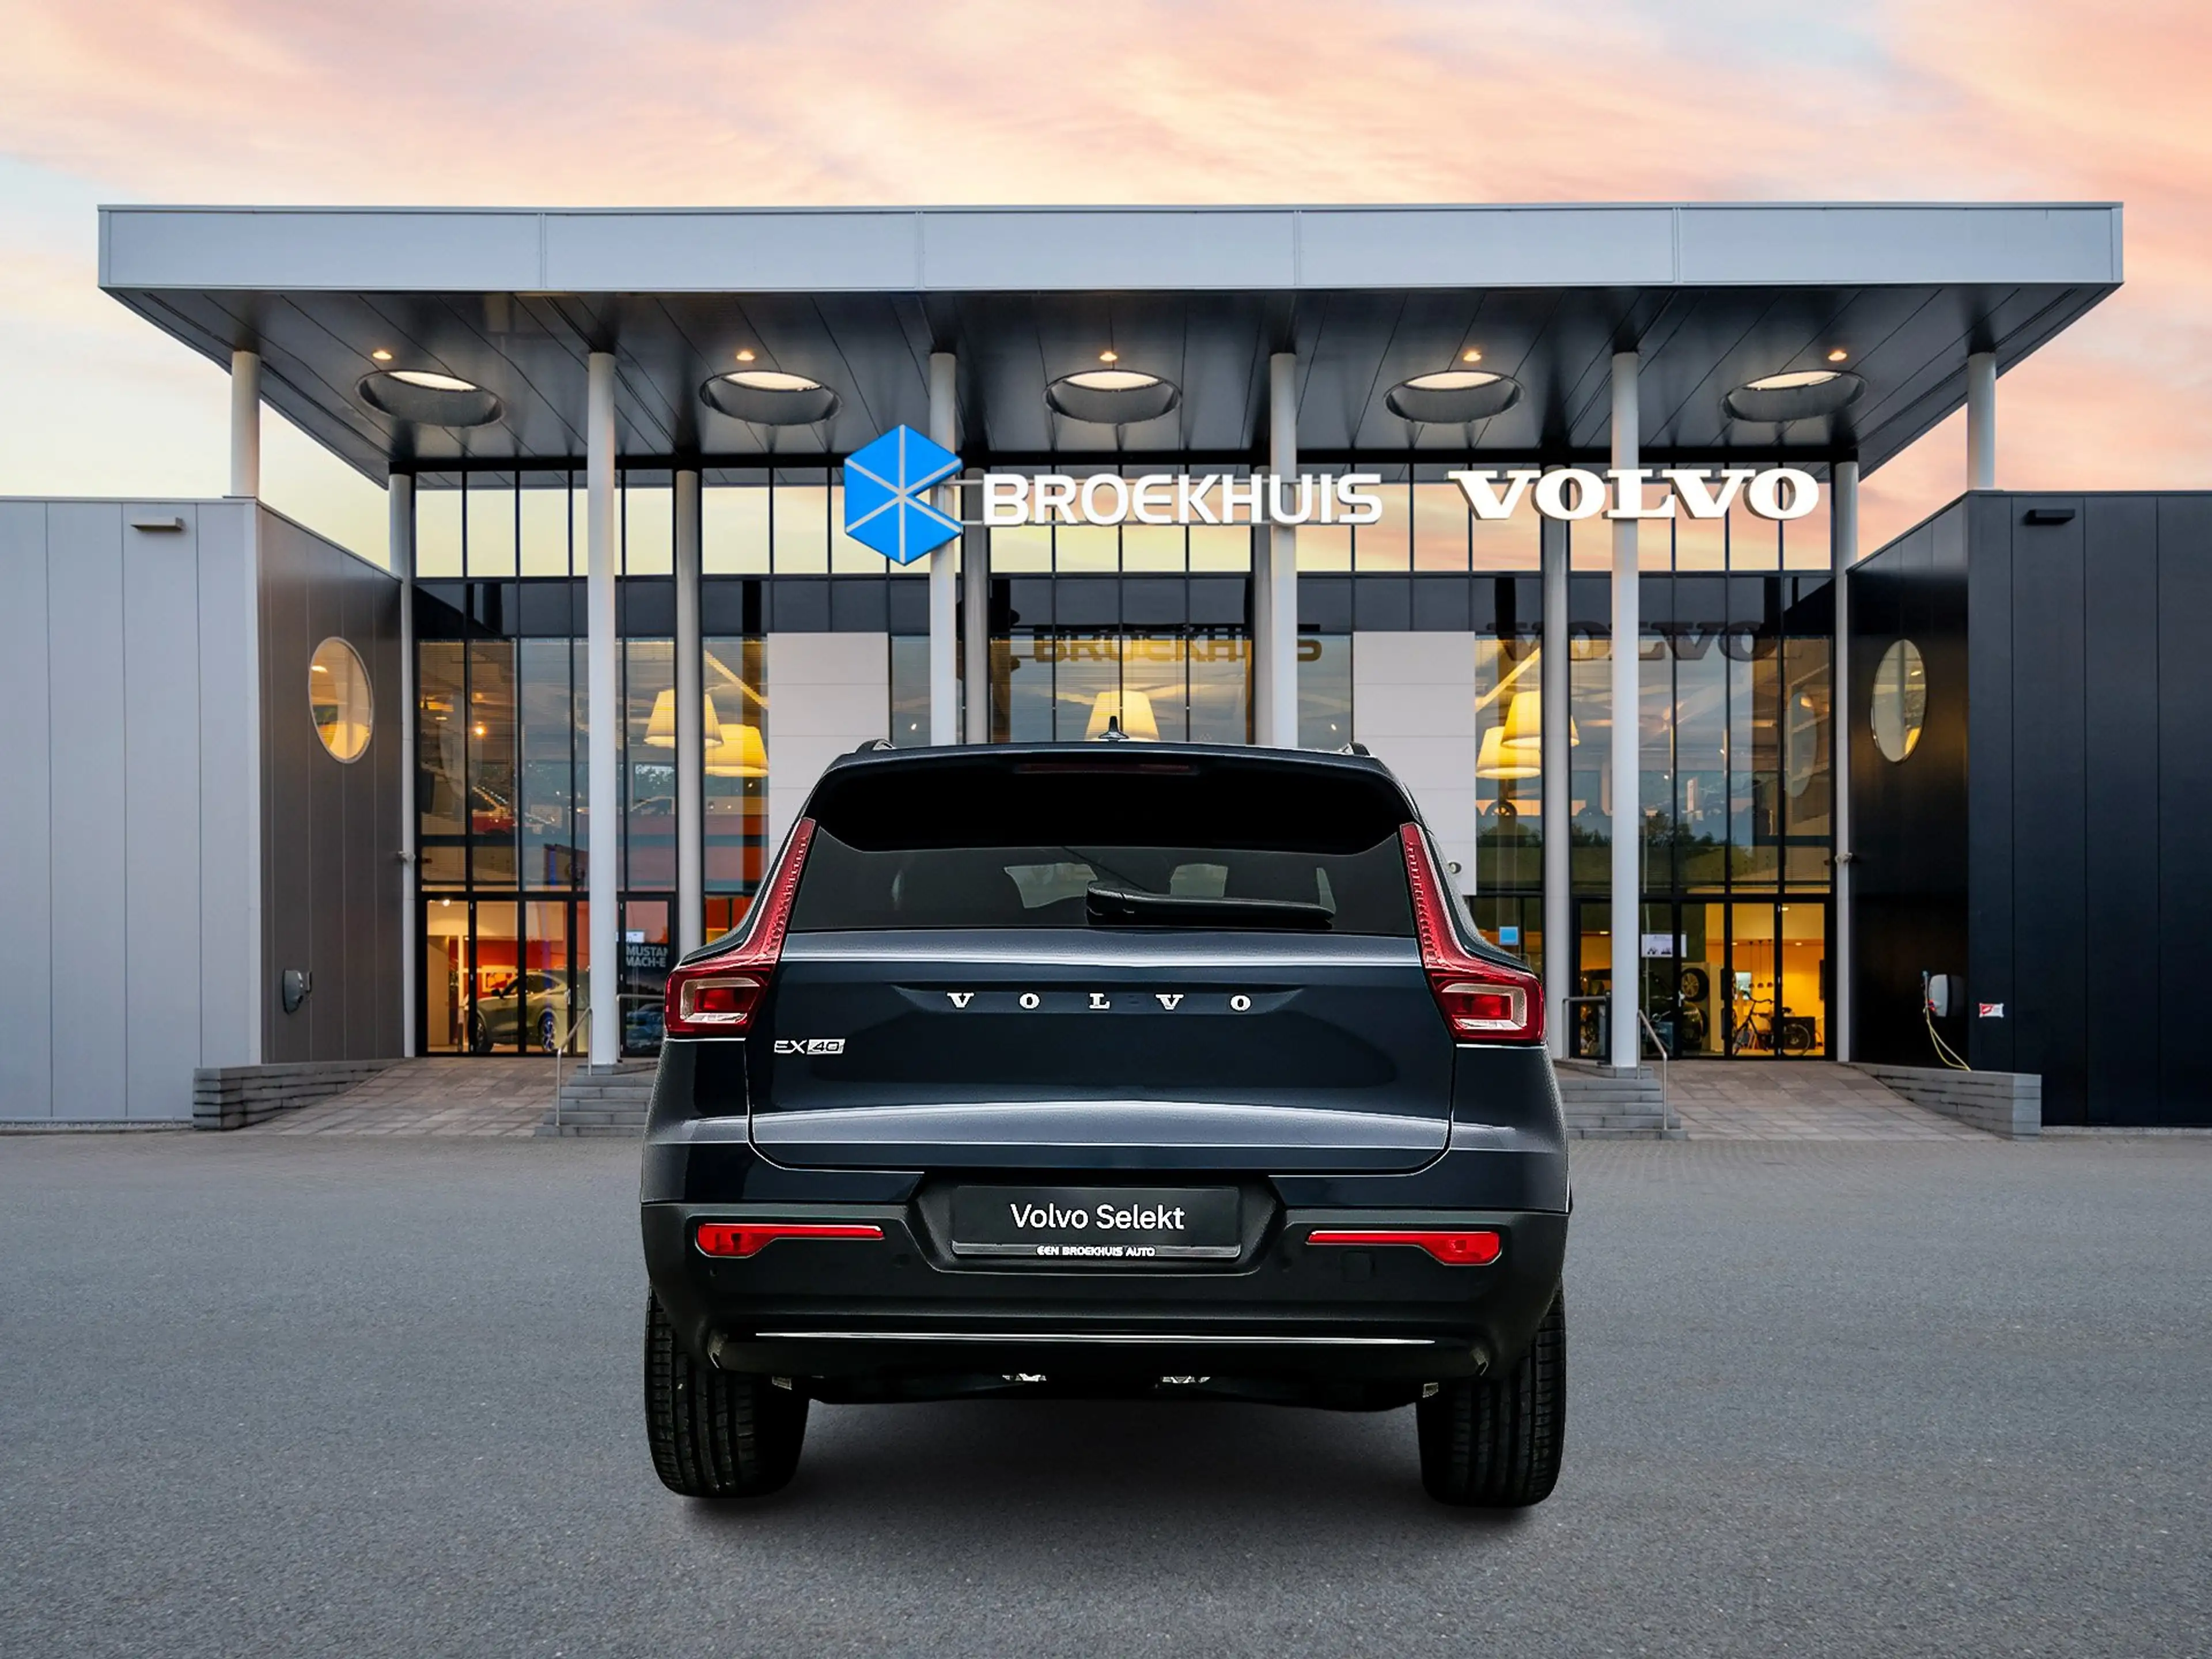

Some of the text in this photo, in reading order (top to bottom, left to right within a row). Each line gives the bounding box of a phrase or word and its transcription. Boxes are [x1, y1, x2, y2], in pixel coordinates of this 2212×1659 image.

[983, 473, 1383, 527] BROEKHUIS
[1445, 467, 1819, 520] VOLVO
[946, 992, 1252, 1012] VOLVO
[774, 1039, 846, 1055] EX40
[1010, 1203, 1185, 1229] Volvo Selekt
[1037, 1246, 1156, 1256] EEN BROEKHUIS AUTO
